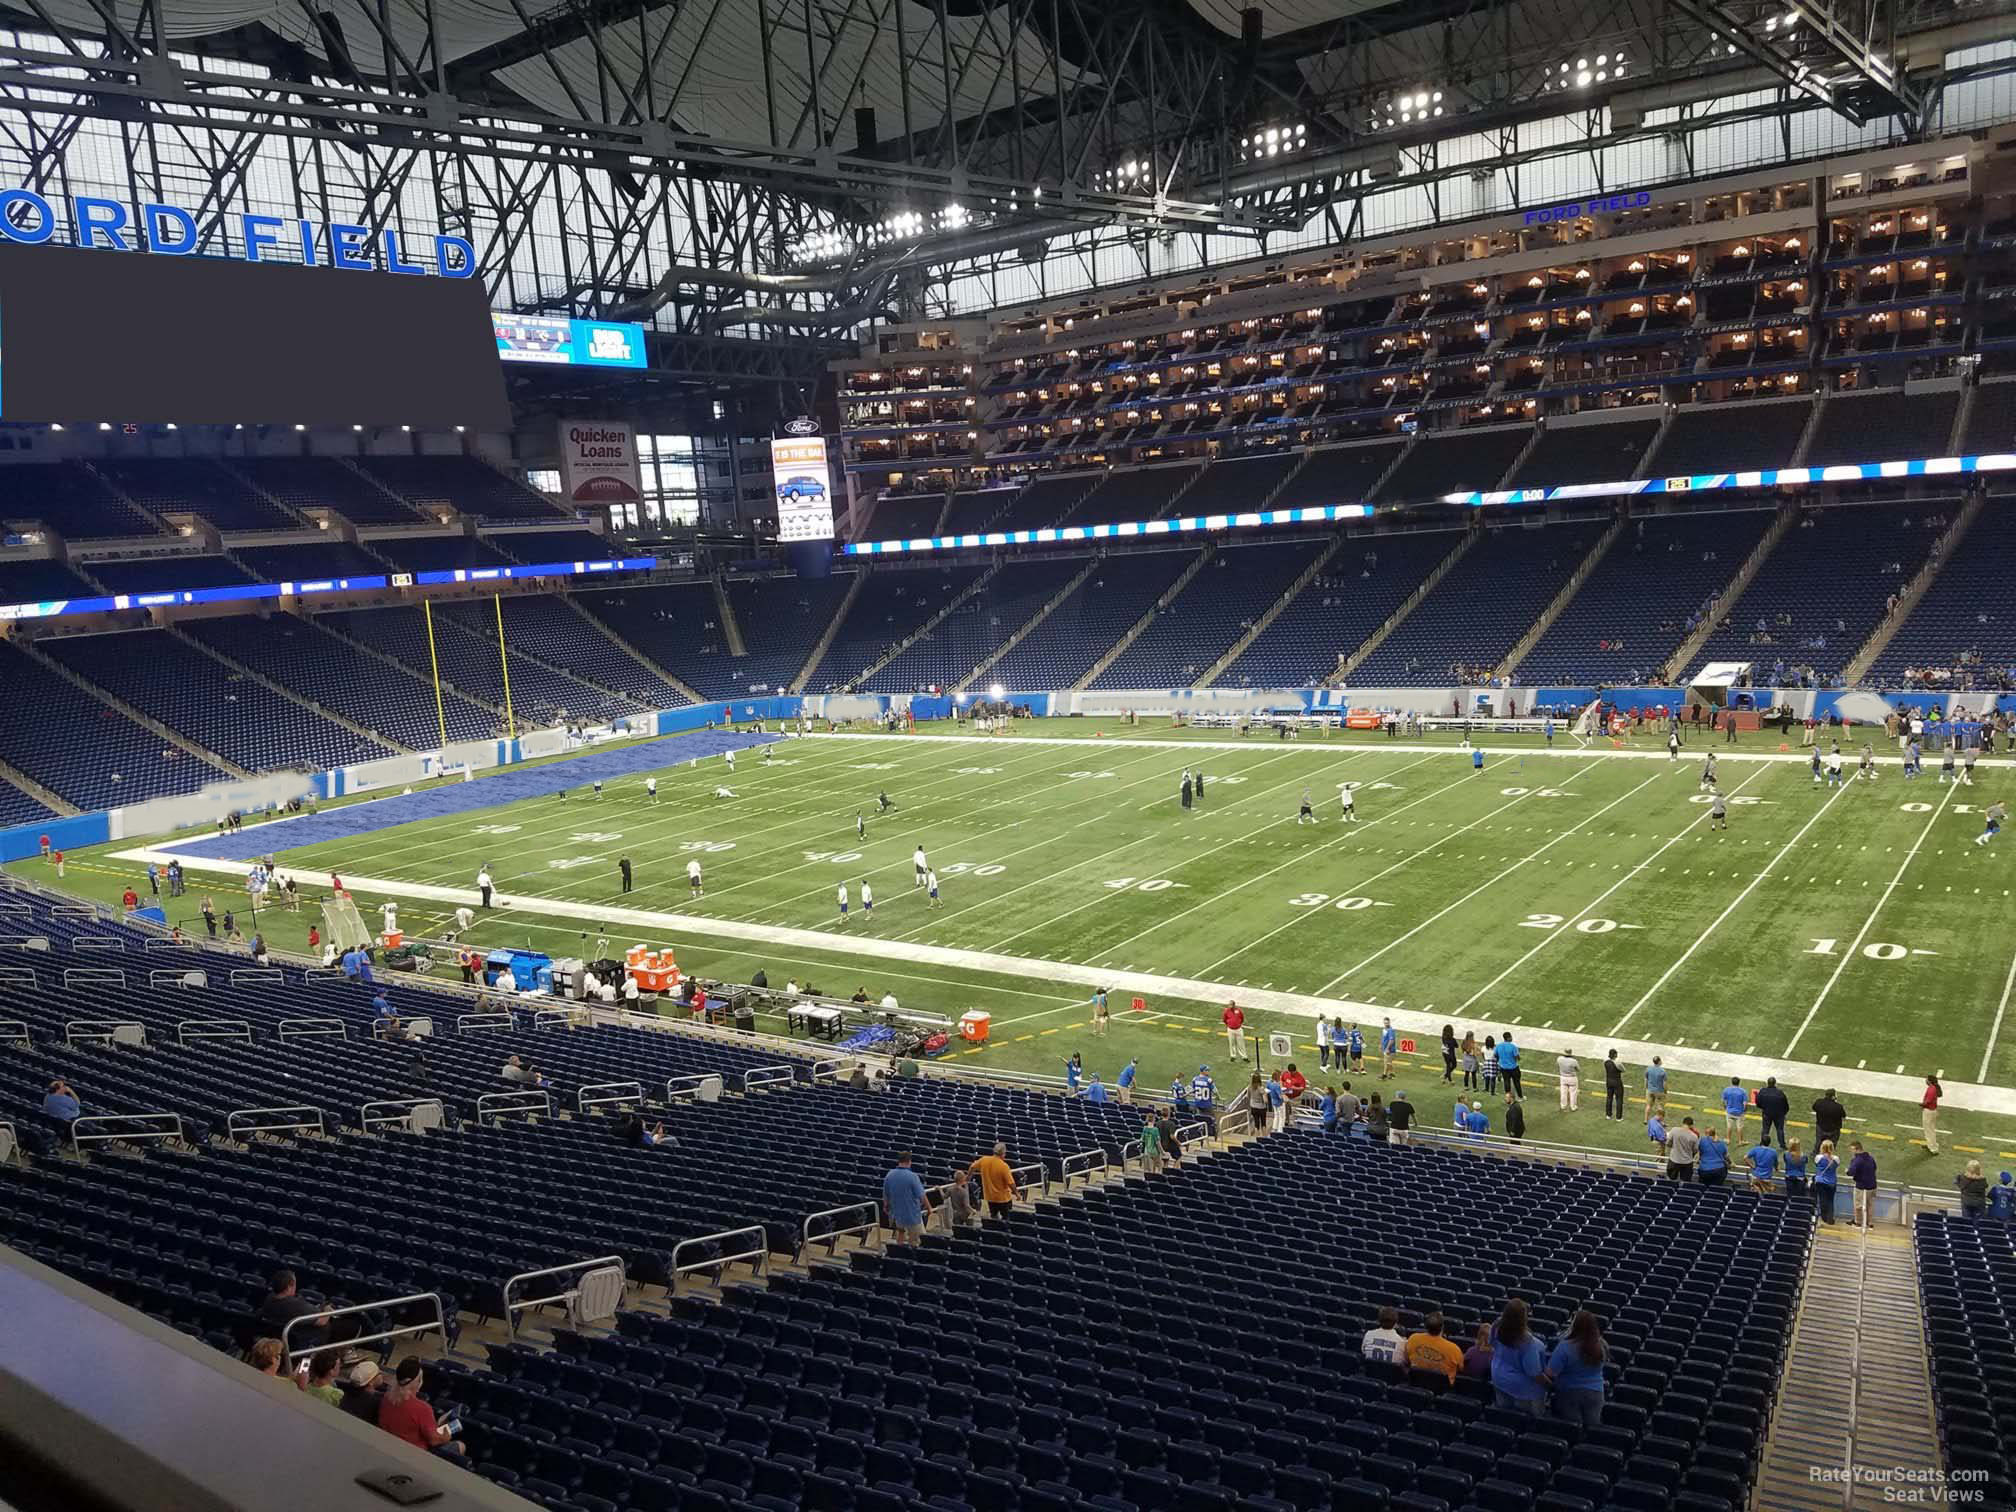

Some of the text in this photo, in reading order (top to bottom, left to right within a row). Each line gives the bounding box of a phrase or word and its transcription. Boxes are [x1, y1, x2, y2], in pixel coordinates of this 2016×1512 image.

[1524, 192, 1650, 225] FORD FIELD
[242, 213, 477, 279] FIELD
[791, 422, 812, 432] Ford
[570, 427, 626, 444] Quicken
[581, 444, 622, 457] Loans
[1103, 877, 1174, 891] 40
[1288, 892, 1373, 910] 30
[1518, 913, 1618, 933] 20
[1803, 938, 1908, 960] 10
[1133, 999, 1143, 1009] 30
[966, 1022, 976, 1036] G
[1401, 1040, 1414, 1052] 20
[1194, 1087, 1210, 1101] 20
